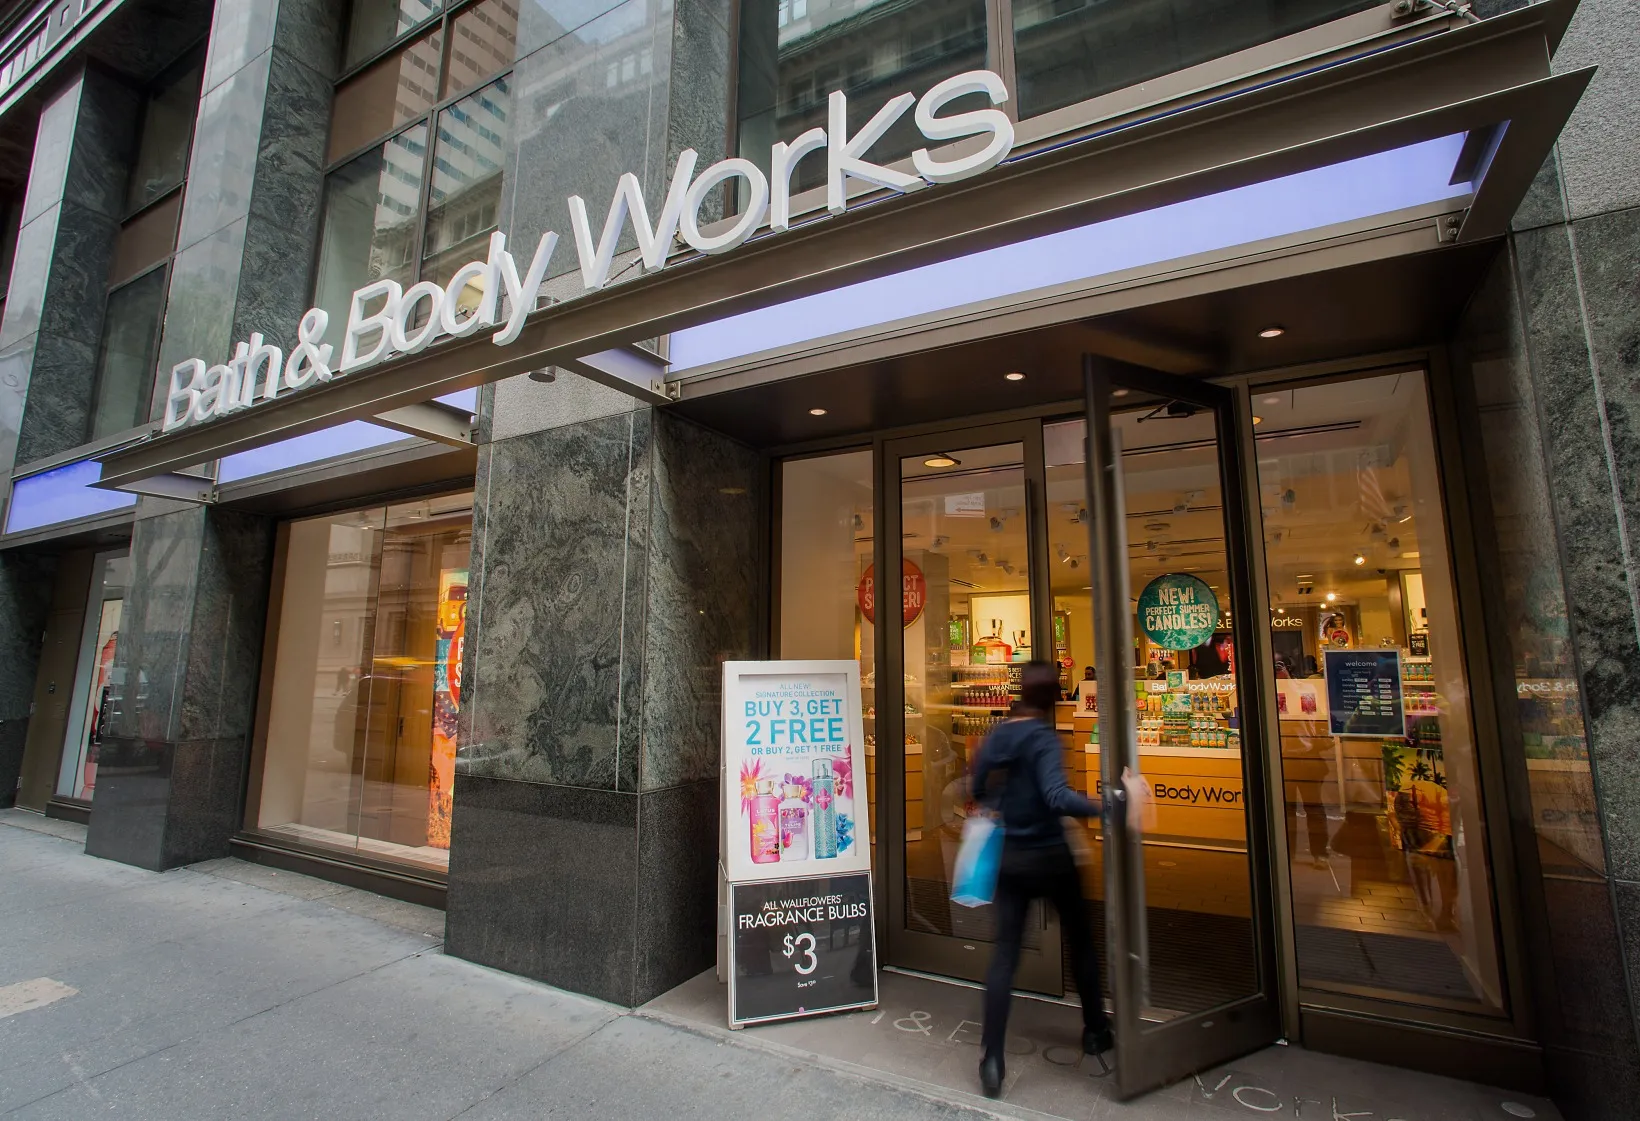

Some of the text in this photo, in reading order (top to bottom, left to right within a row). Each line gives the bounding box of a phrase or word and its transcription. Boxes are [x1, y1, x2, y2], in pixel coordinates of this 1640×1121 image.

[162, 69, 1014, 433] Bath & Body Works
[1158, 587, 1195, 605] NEW!
[1145, 603, 1210, 615] PERFECT SUMMER
[1146, 613, 1212, 631] CANDLES!
[1271, 617, 1303, 627] orks
[745, 700, 783, 717] BUY
[807, 699, 843, 715] GET
[745, 718, 844, 745] 2 FREE
[751, 747, 763, 755] OR
[766, 746, 783, 755] BUY
[795, 745, 811, 753] GET
[820, 744, 842, 752] FREE
[1155, 784, 1244, 803] Body Wor
[763, 901, 778, 911] ALL
[739, 903, 867, 929] FRAGRANCE BULBS
[782, 932, 818, 975] $3
[893, 1010, 933, 1036] &
